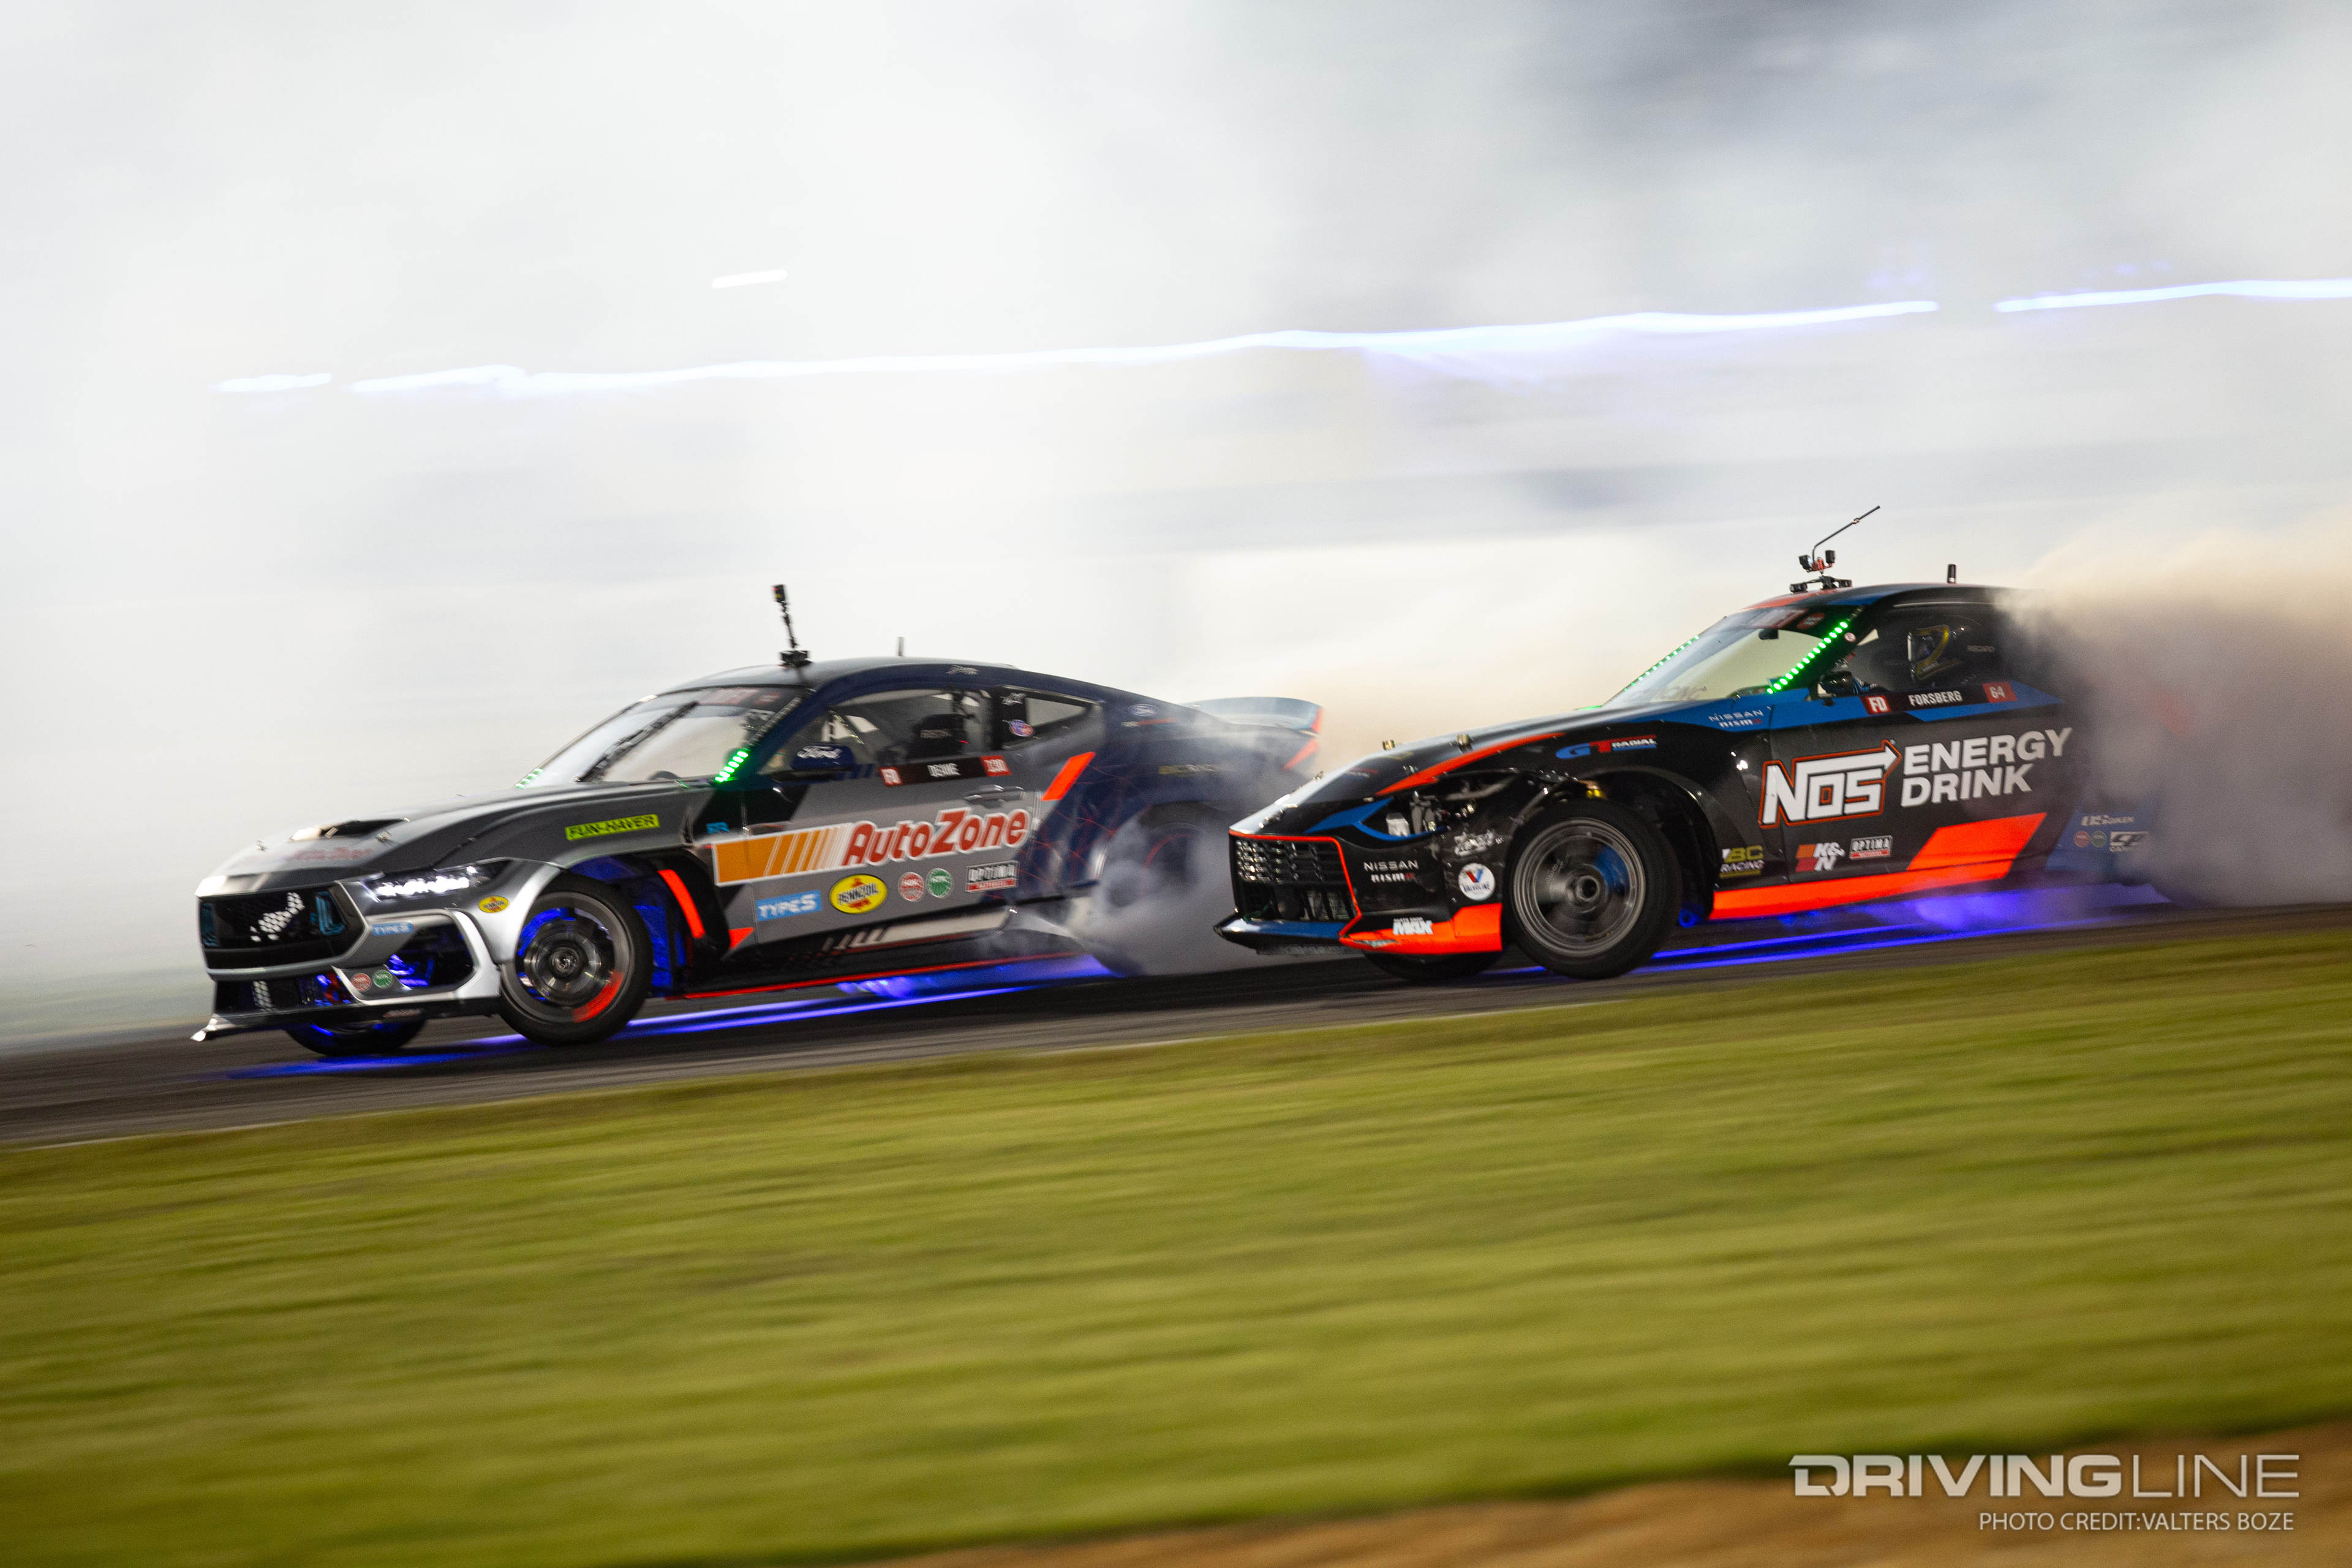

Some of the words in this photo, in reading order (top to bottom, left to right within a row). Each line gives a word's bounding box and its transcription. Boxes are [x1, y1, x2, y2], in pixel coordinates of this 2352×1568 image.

[1868, 696, 1887, 713] FD
[1908, 690, 1962, 706] FORSBERG
[1989, 685, 2006, 699] 64
[1708, 710, 1763, 722] NISSAN
[1611, 738, 1657, 748] RADIAL
[797, 745, 843, 759] Ford
[1763, 745, 1902, 824] NOS
[1903, 727, 2073, 775] ENERGY
[1901, 763, 2034, 807] DRINK
[840, 810, 1029, 866] AutoZone
[1852, 838, 1890, 852] OPTIMA
[1363, 860, 1419, 872] NISSAN
[1719, 859, 1764, 873] RACING
